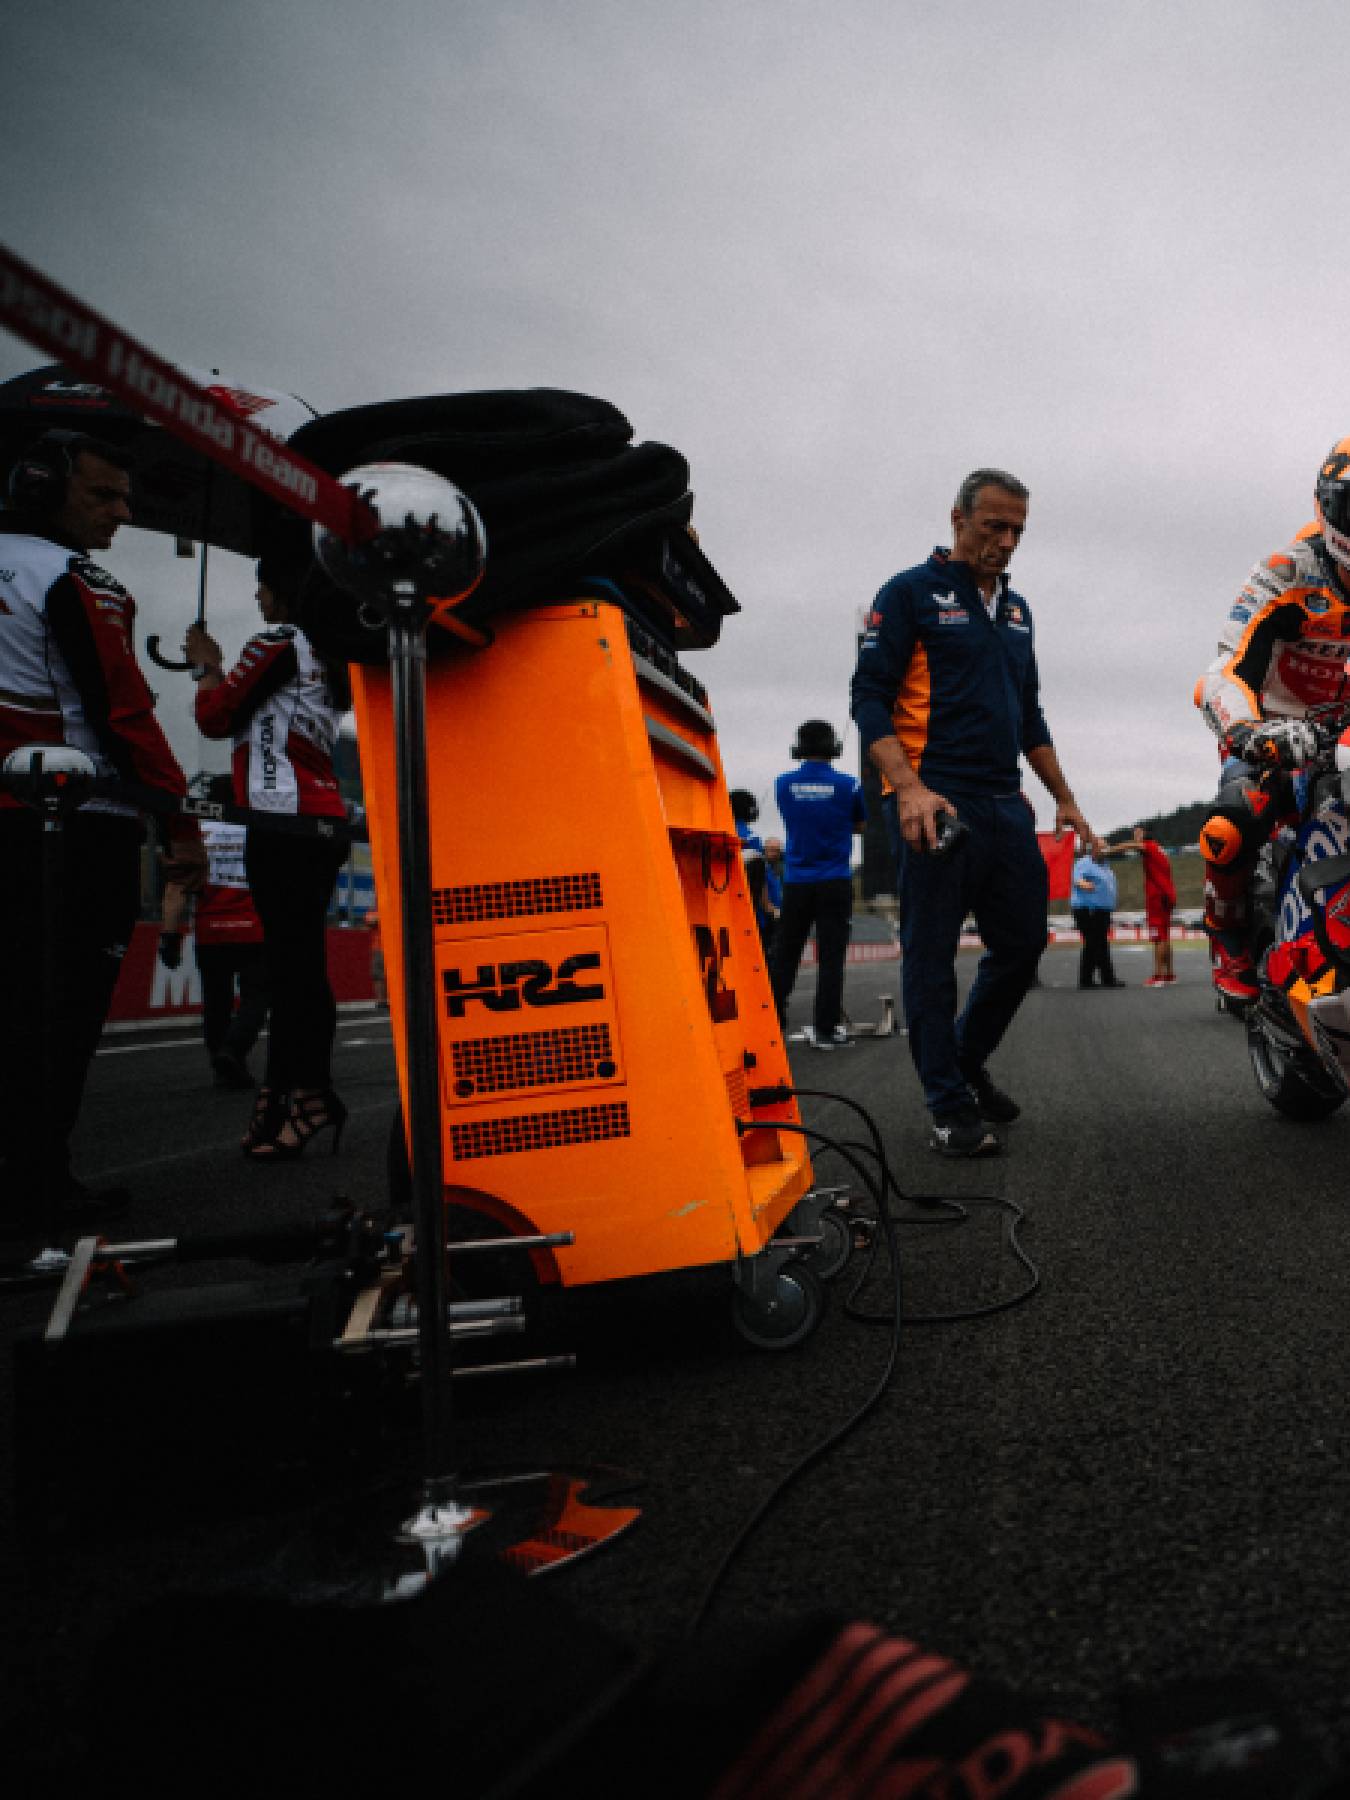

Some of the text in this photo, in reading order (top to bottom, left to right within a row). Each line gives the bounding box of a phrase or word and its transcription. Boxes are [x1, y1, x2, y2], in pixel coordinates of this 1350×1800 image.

[106, 336, 236, 451] Honda
[236, 425, 319, 504] Team
[442, 952, 605, 1018] HRC
